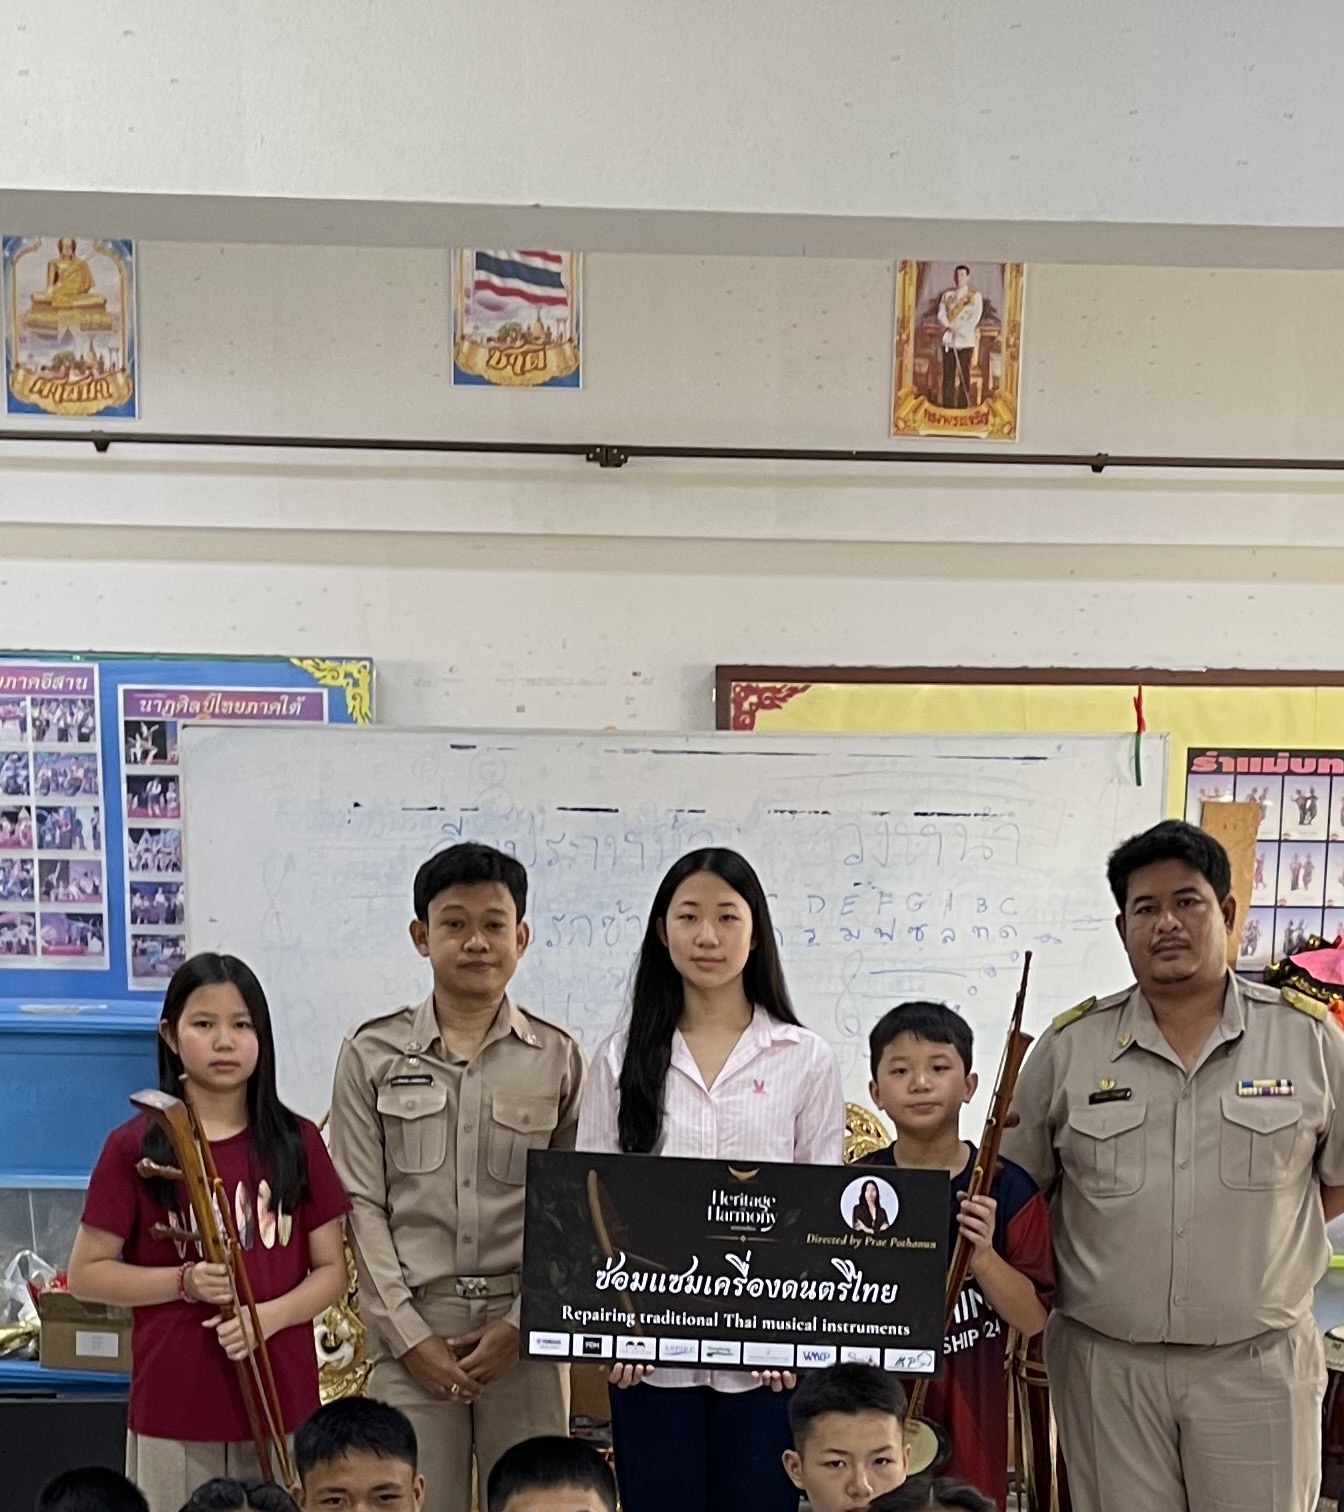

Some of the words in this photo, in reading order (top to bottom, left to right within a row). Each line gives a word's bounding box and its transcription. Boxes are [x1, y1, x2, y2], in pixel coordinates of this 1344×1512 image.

[1191, 751, 1344, 774] รำแม่บท
[711, 1189, 777, 1214] Heritage
[707, 1205, 779, 1233] Harmony
[806, 1233, 848, 1245] Directed
[849, 1234, 862, 1249] by
[865, 1235, 887, 1247] Prae
[595, 1250, 899, 1304] ซ่อมแซมเครื่องดนตรีไทย
[561, 1305, 636, 1327] Repairing
[639, 1308, 719, 1328] traditional
[723, 1313, 757, 1329] Thai
[761, 1315, 818, 1332] musical
[822, 1317, 911, 1336] instruments
